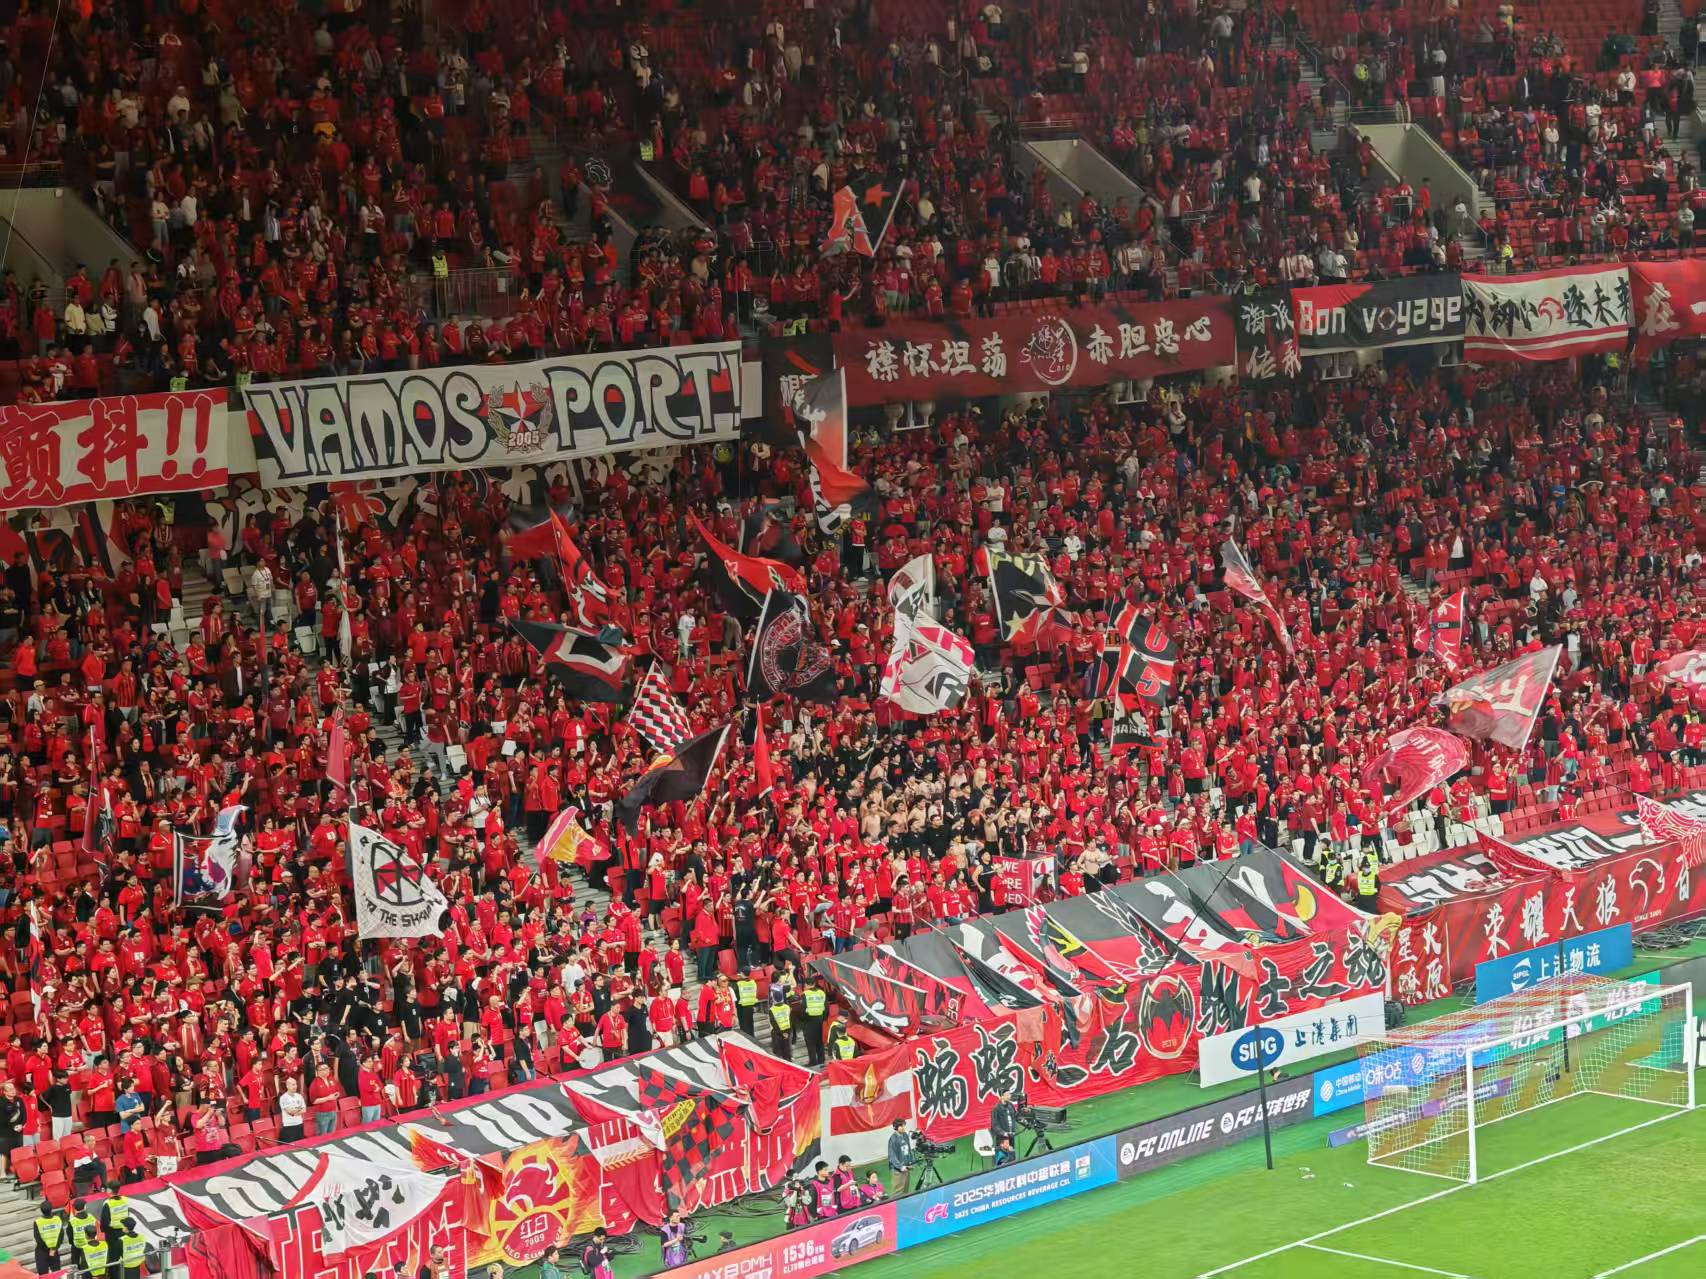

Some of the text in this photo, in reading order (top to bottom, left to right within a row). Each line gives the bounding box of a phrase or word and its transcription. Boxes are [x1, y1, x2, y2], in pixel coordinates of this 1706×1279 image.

[1298, 295, 1462, 336] Bon voyage
[864, 331, 1008, 383] 襟怀坦荡
[1085, 315, 1214, 365] 赤胆忠心
[542, 350, 742, 452] PORT!
[245, 371, 490, 480] VAMOS
[507, 431, 540, 448] 2005
[1002, 860, 1020, 874] WE
[1006, 877, 1023, 890] RE
[379, 907, 399, 927] THE
[1007, 893, 1023, 905] ED
[1483, 872, 1621, 961] 荣耀天狼
[1397, 922, 1442, 964] 星火
[1398, 957, 1448, 1005] 燎原
[1234, 1104, 1257, 1129] FC
[1134, 1118, 1215, 1161] FC ONLINE
